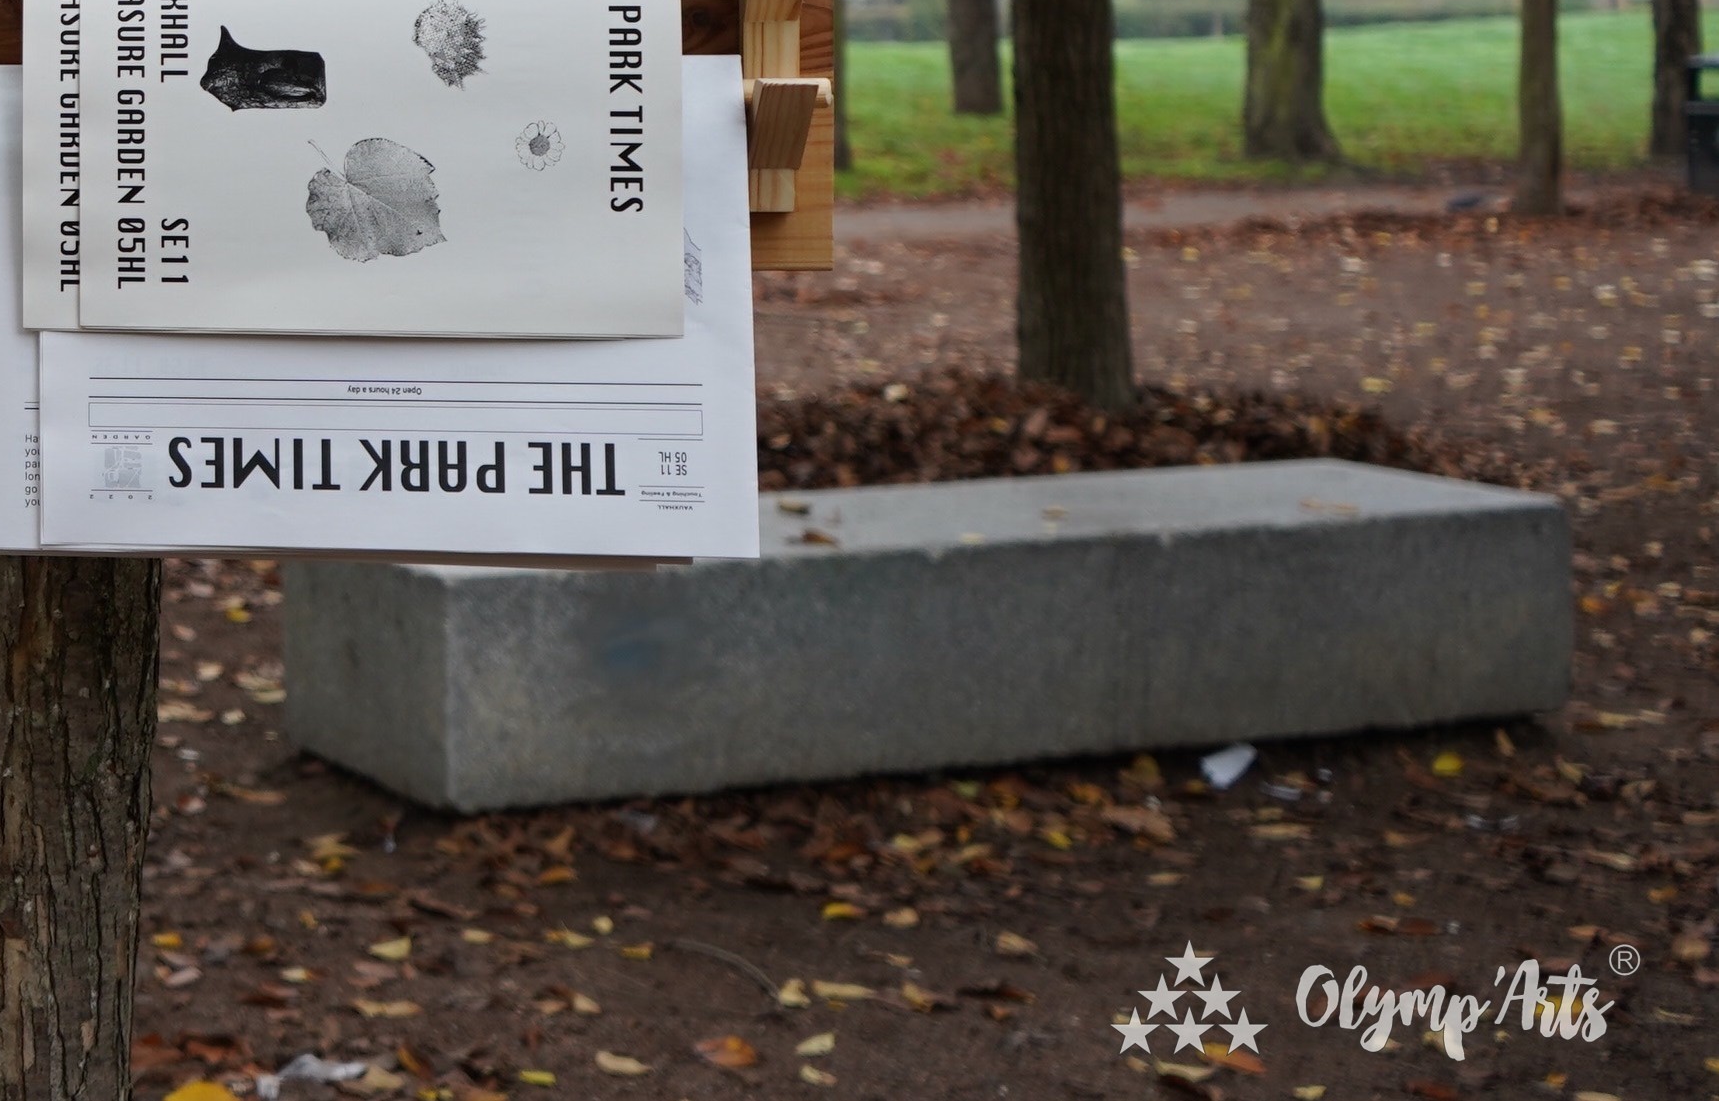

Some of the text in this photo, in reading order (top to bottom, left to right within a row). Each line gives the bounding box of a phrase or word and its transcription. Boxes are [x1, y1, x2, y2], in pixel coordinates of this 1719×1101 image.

[609, 5, 643, 94] PARK
[117, 89, 146, 204] GARDEN
[609, 105, 644, 213] TIMES
[160, 218, 190, 283] SE11
[347, 385, 361, 395] day
[368, 386, 390, 395] hours
[391, 387, 401, 396] 24
[403, 386, 422, 396] Open
[25, 434, 40, 443] Ha
[658, 451, 687, 463] 05 HL
[168, 436, 626, 496] THE PARK TIMES
[660, 464, 688, 476] SE 11
[24, 486, 38, 495] go
